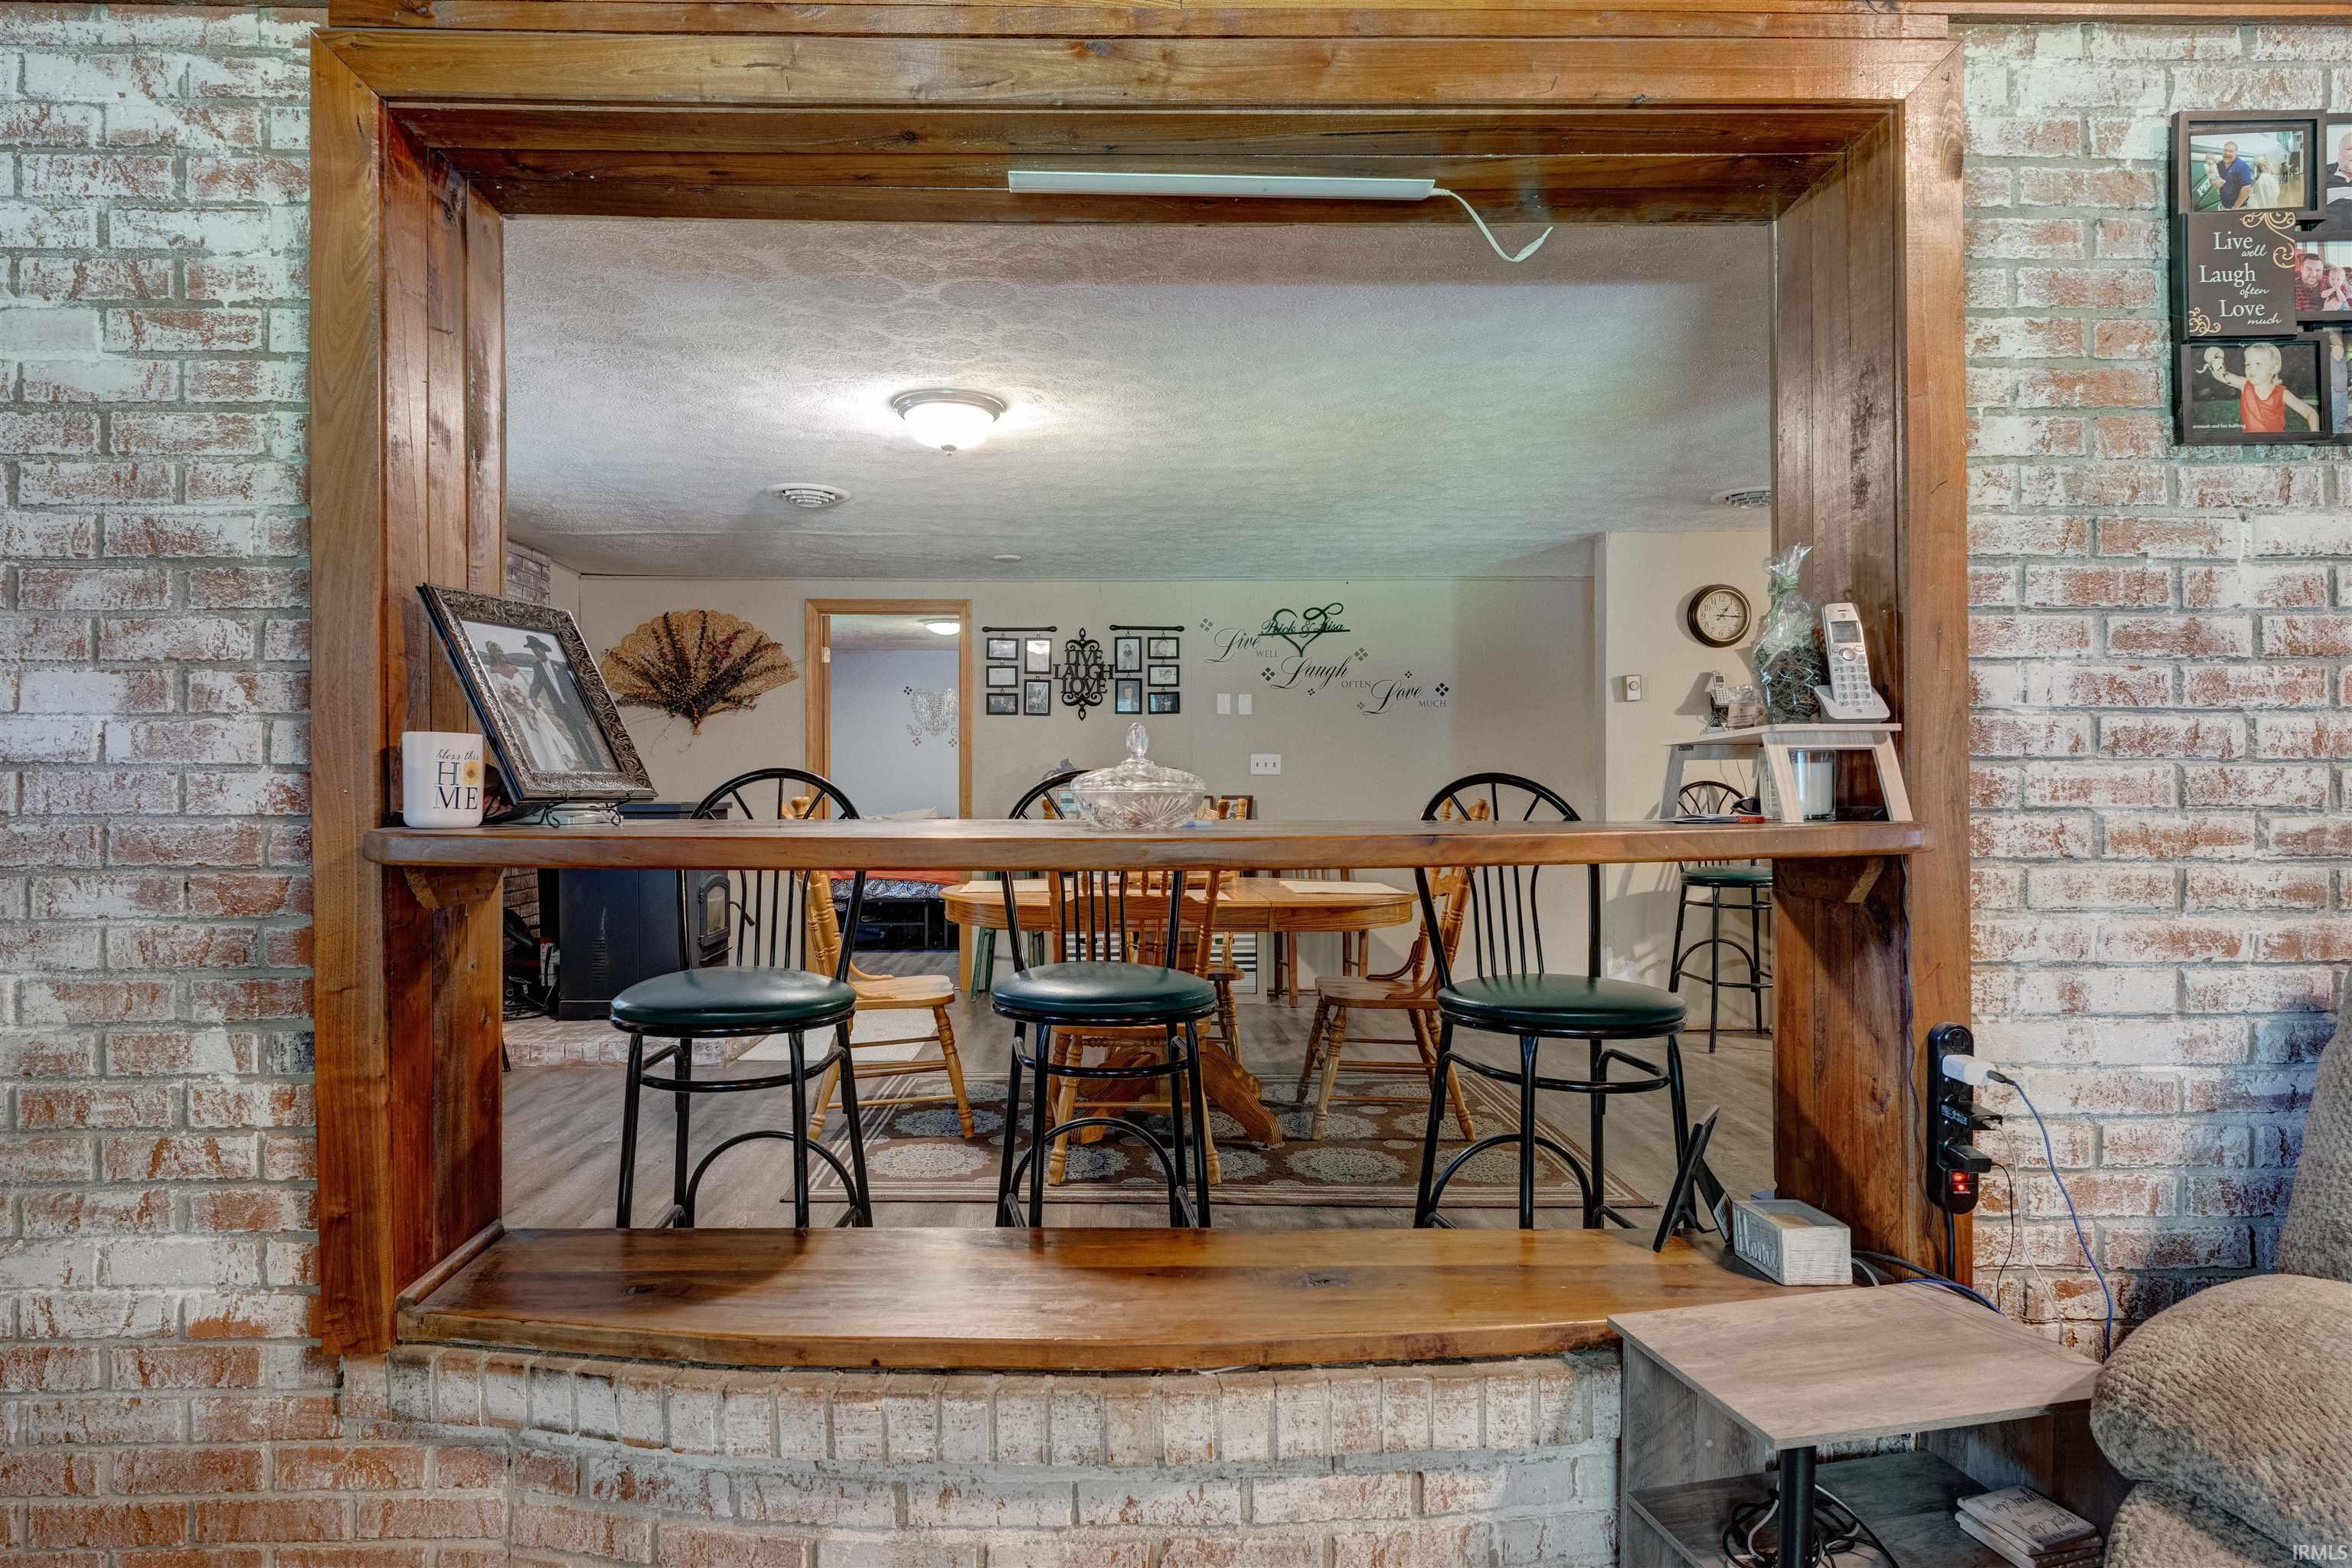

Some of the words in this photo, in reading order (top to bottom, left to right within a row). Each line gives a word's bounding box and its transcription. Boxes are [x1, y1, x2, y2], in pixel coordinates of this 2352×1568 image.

[2213, 230, 2253, 250] Live
[2241, 244, 2267, 257] well
[2198, 262, 2257, 288] Laugh
[2239, 283, 2270, 299] often
[2218, 299, 2265, 317] Love
[2247, 312, 2283, 325] much
[1204, 628, 1262, 663] Live
[1256, 649, 1279, 658] WELL
[1064, 649, 1103, 665] LIVE
[1053, 662, 1115, 680] LAUGH
[1270, 655, 1353, 689] Laugh
[1060, 678, 1108, 694] LOVE
[1341, 679, 1371, 689] OFTEN
[1362, 680, 1422, 714] Love
[1419, 699, 1447, 708] MUCH
[436, 748, 461, 760] bless
